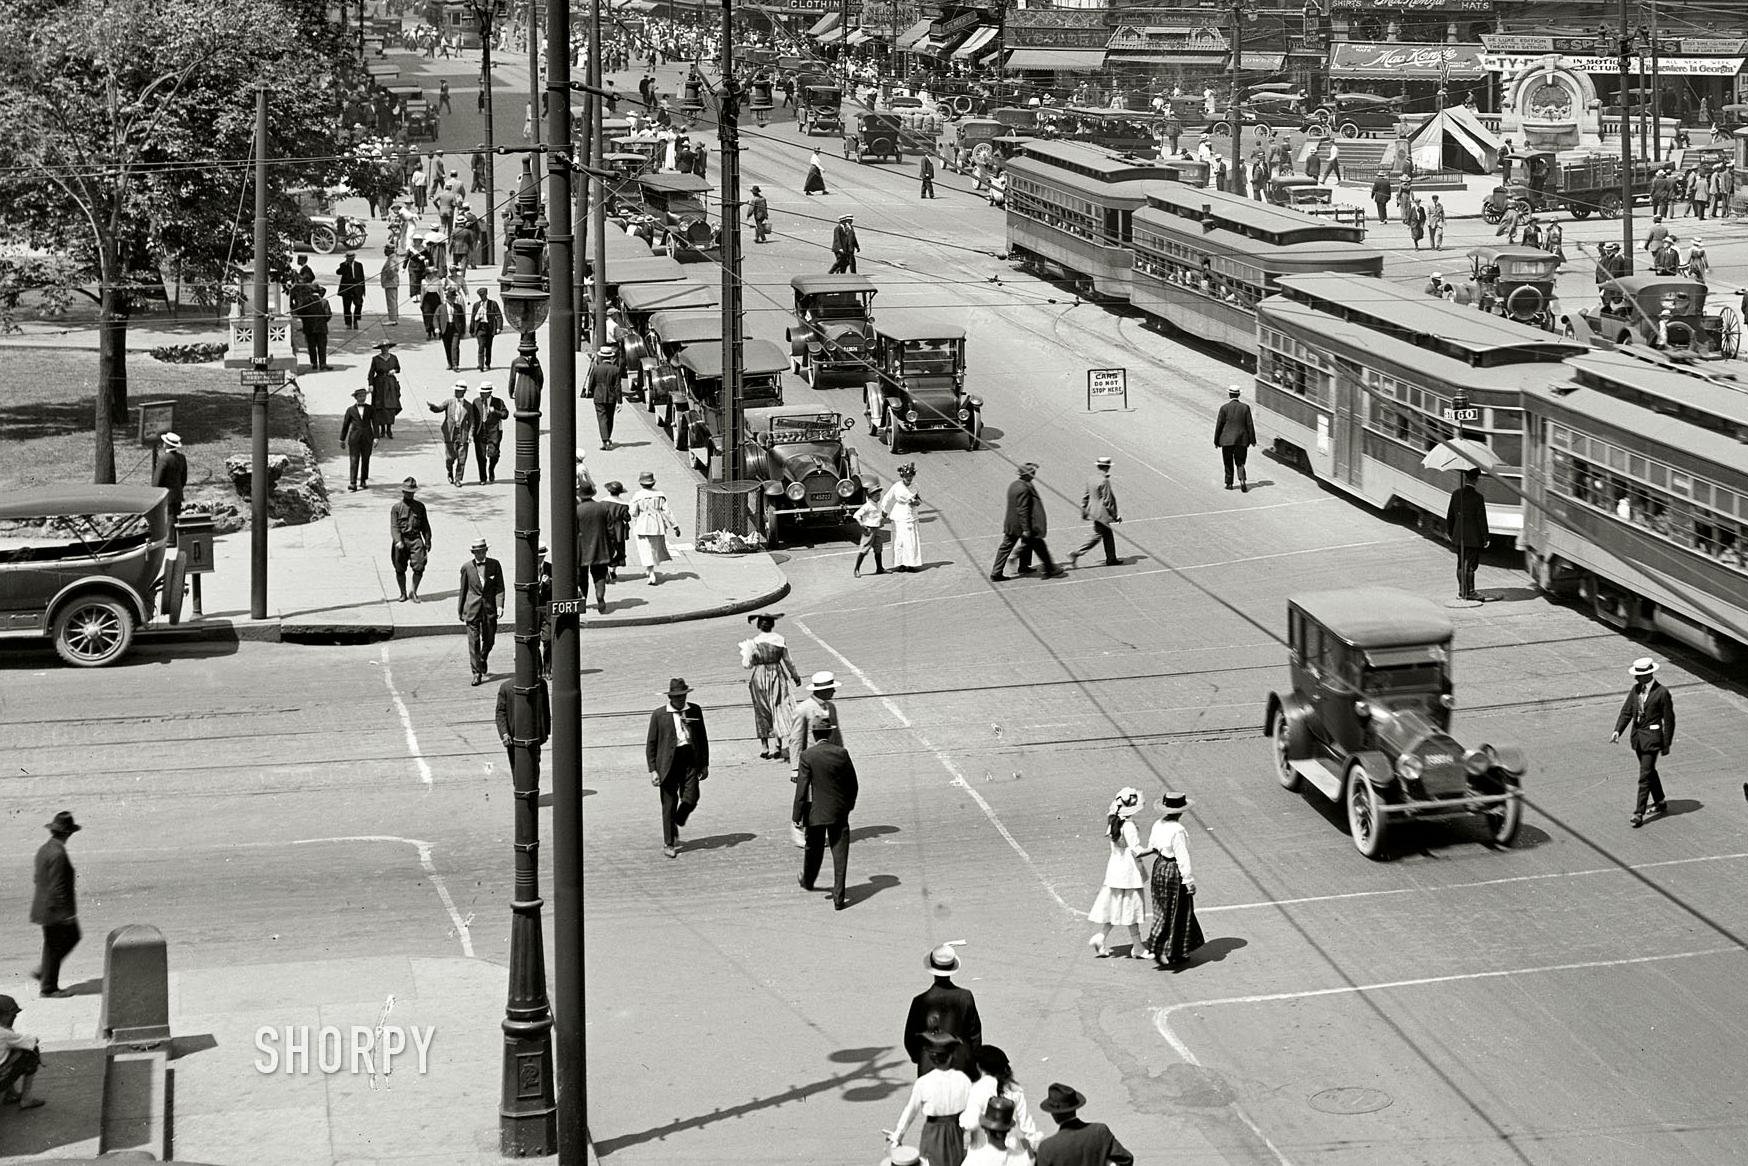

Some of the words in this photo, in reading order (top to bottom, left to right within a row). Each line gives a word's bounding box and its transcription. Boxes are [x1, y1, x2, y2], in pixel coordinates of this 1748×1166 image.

[1461, 1, 1490, 9] HATS
[251, 357, 267, 365] FORT
[1095, 372, 1118, 380] CARS
[1457, 410, 1474, 420] GO
[552, 601, 580, 614] FORT
